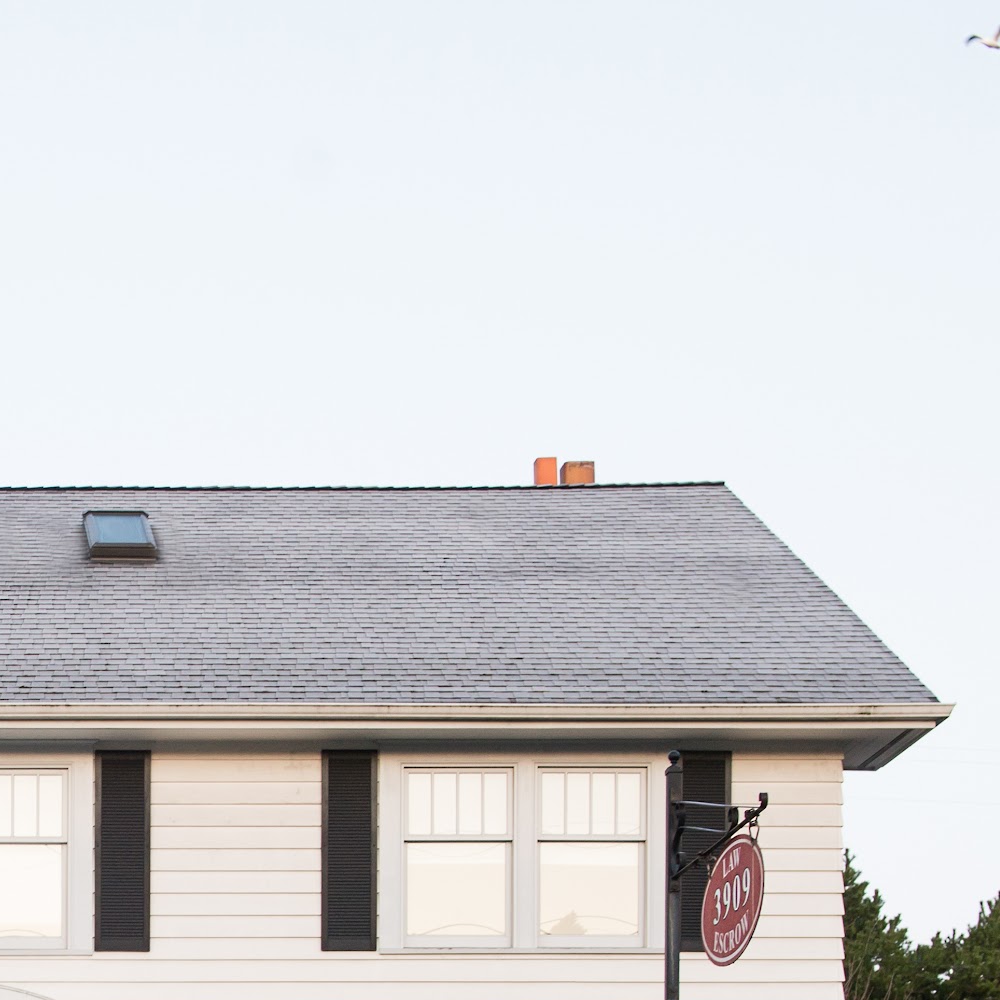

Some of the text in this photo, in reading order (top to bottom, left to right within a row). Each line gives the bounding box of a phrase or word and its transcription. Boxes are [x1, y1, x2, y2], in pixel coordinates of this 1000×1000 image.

[722, 847, 742, 879] LAW
[713, 867, 751, 926] 3909
[713, 910, 749, 954] ESCROW
